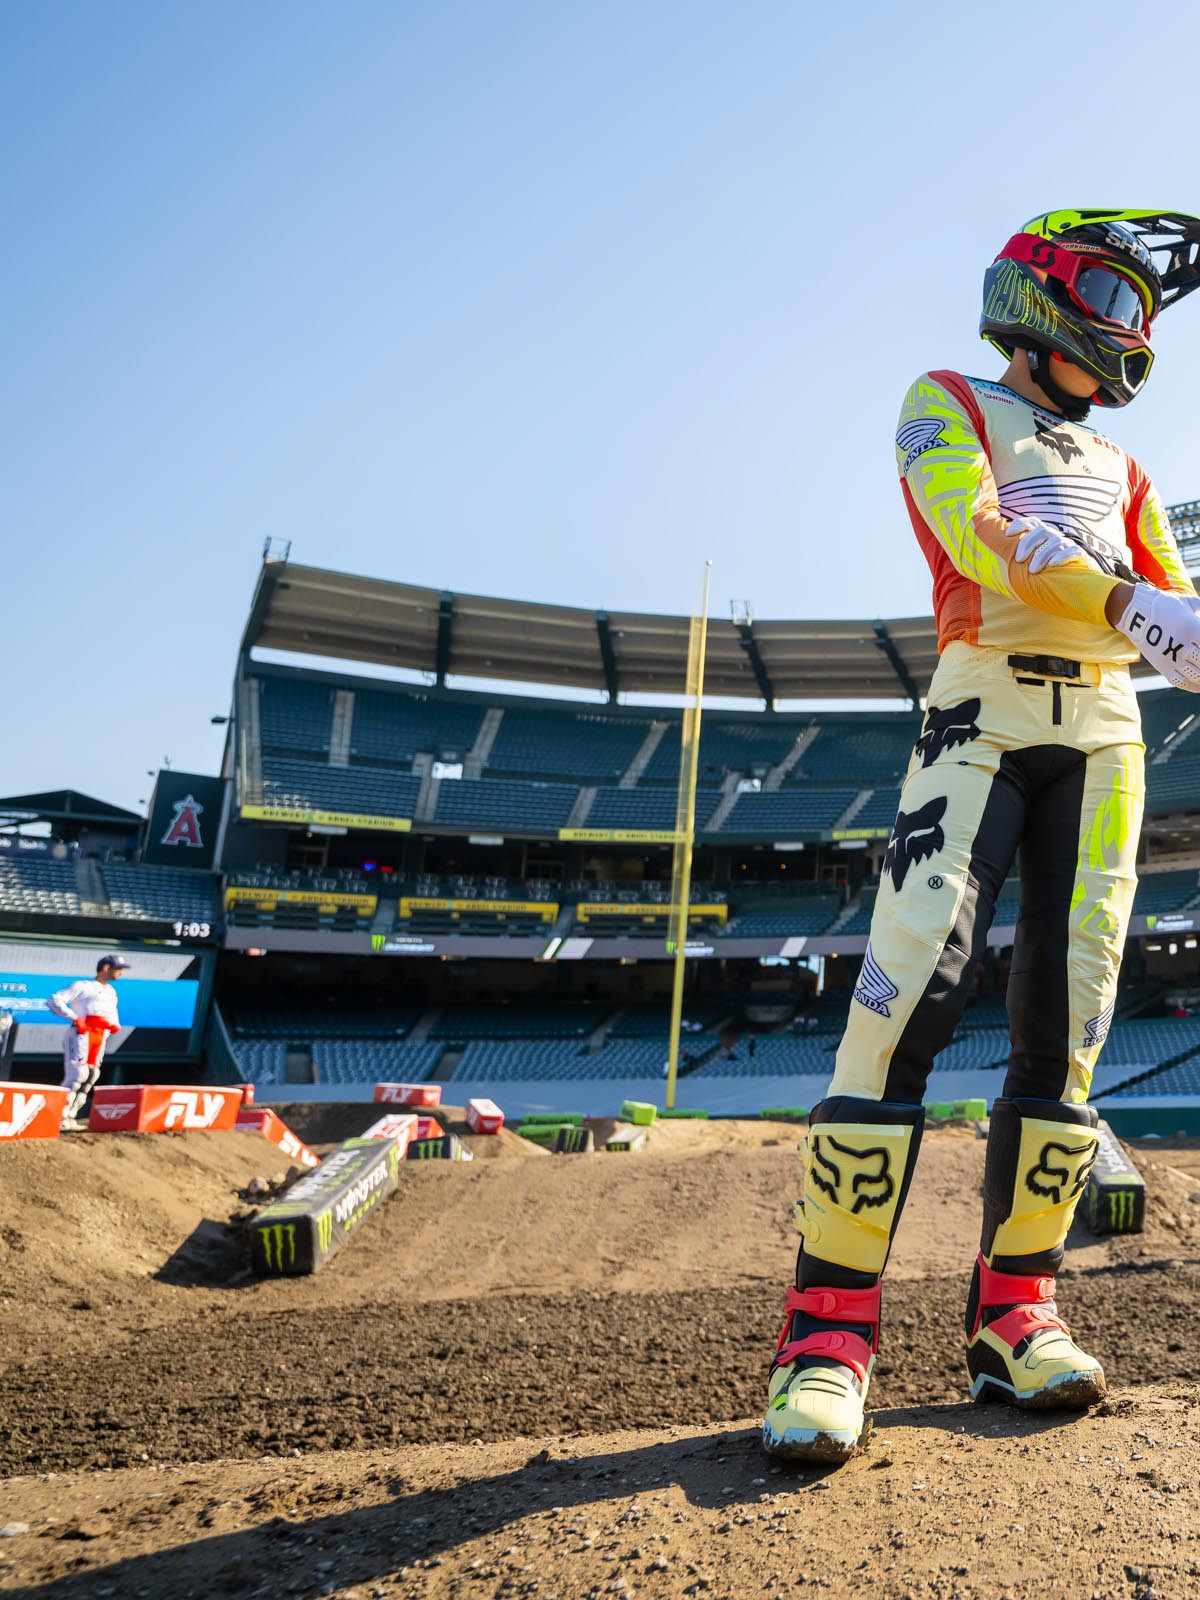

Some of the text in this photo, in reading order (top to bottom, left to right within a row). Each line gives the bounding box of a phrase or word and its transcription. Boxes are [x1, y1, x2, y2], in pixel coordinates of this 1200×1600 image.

[1128, 611, 1184, 662] FOX
[172, 921, 211, 938] 1:03
[853, 988, 891, 1017] ONDA
[165, 1092, 225, 1128] FLY
